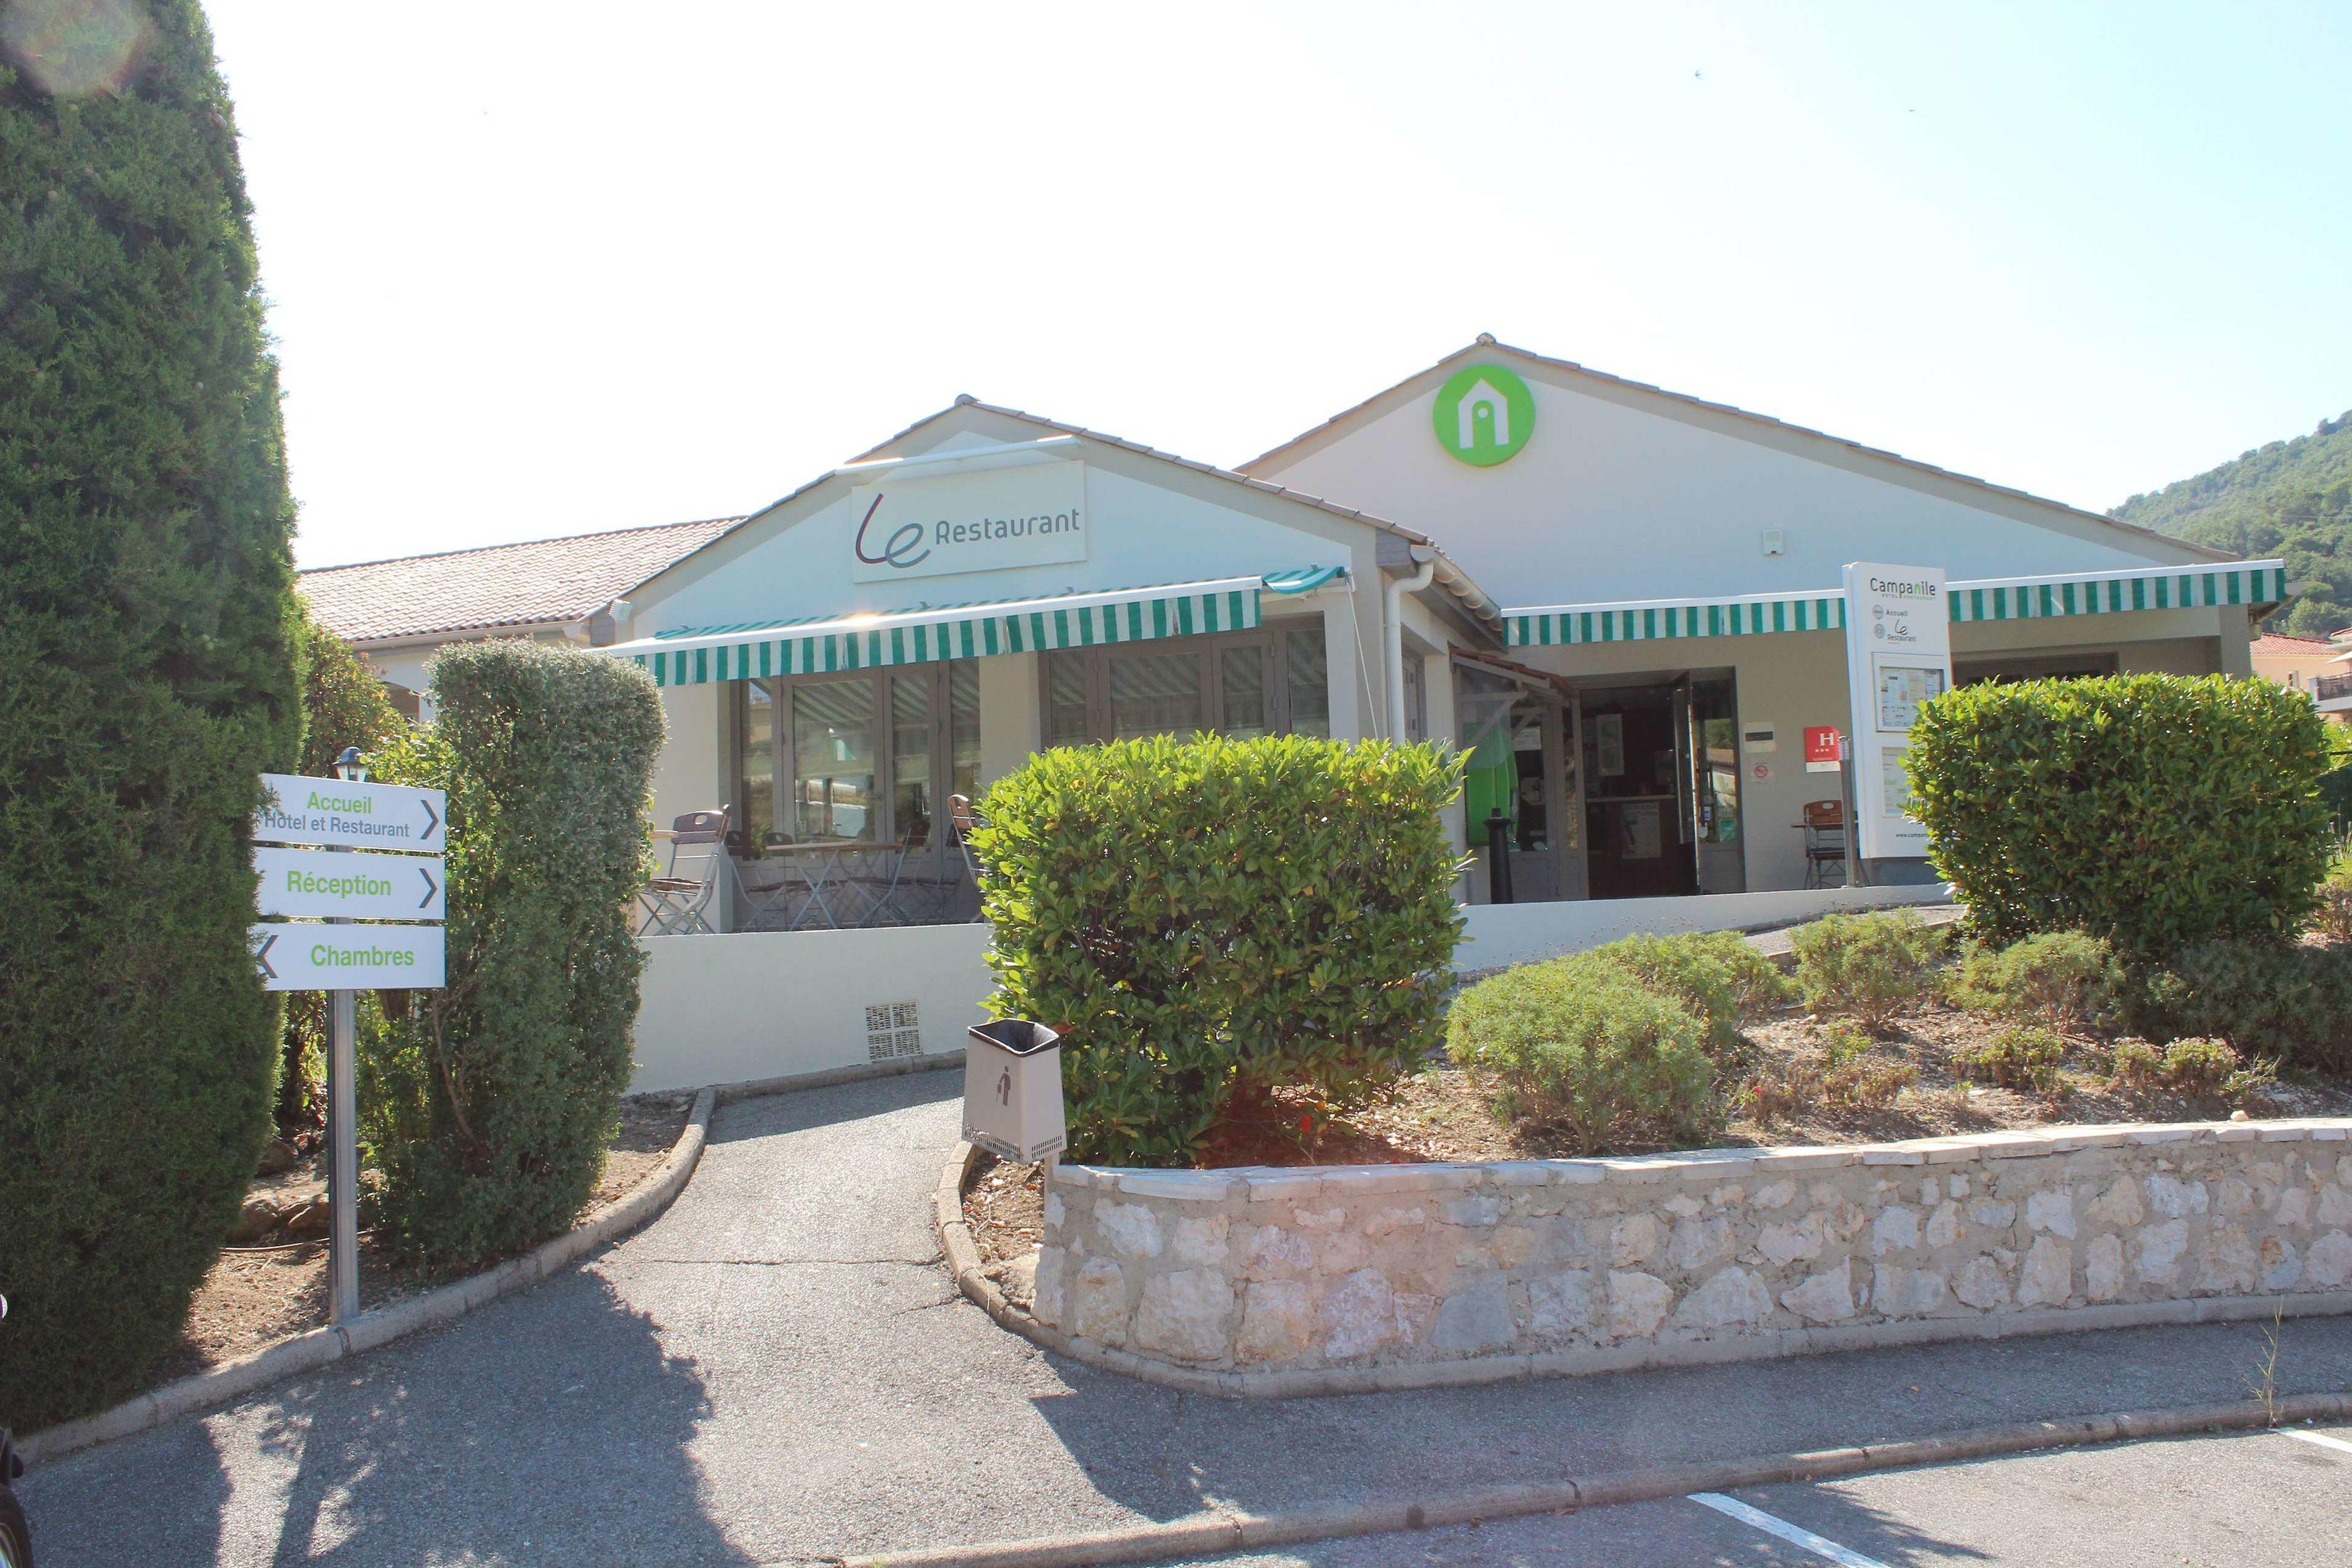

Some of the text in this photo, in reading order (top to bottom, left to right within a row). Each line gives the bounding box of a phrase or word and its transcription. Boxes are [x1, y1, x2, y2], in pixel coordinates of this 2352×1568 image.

[936, 508, 1080, 545] Restaurant
[1870, 577, 1935, 599] Campanile
[1819, 732, 1835, 746] H
[307, 791, 372, 814] Accueil
[311, 817, 326, 831] et
[330, 817, 409, 838] Restaurant
[287, 870, 391, 899] Réception
[311, 944, 415, 966] Chambres
